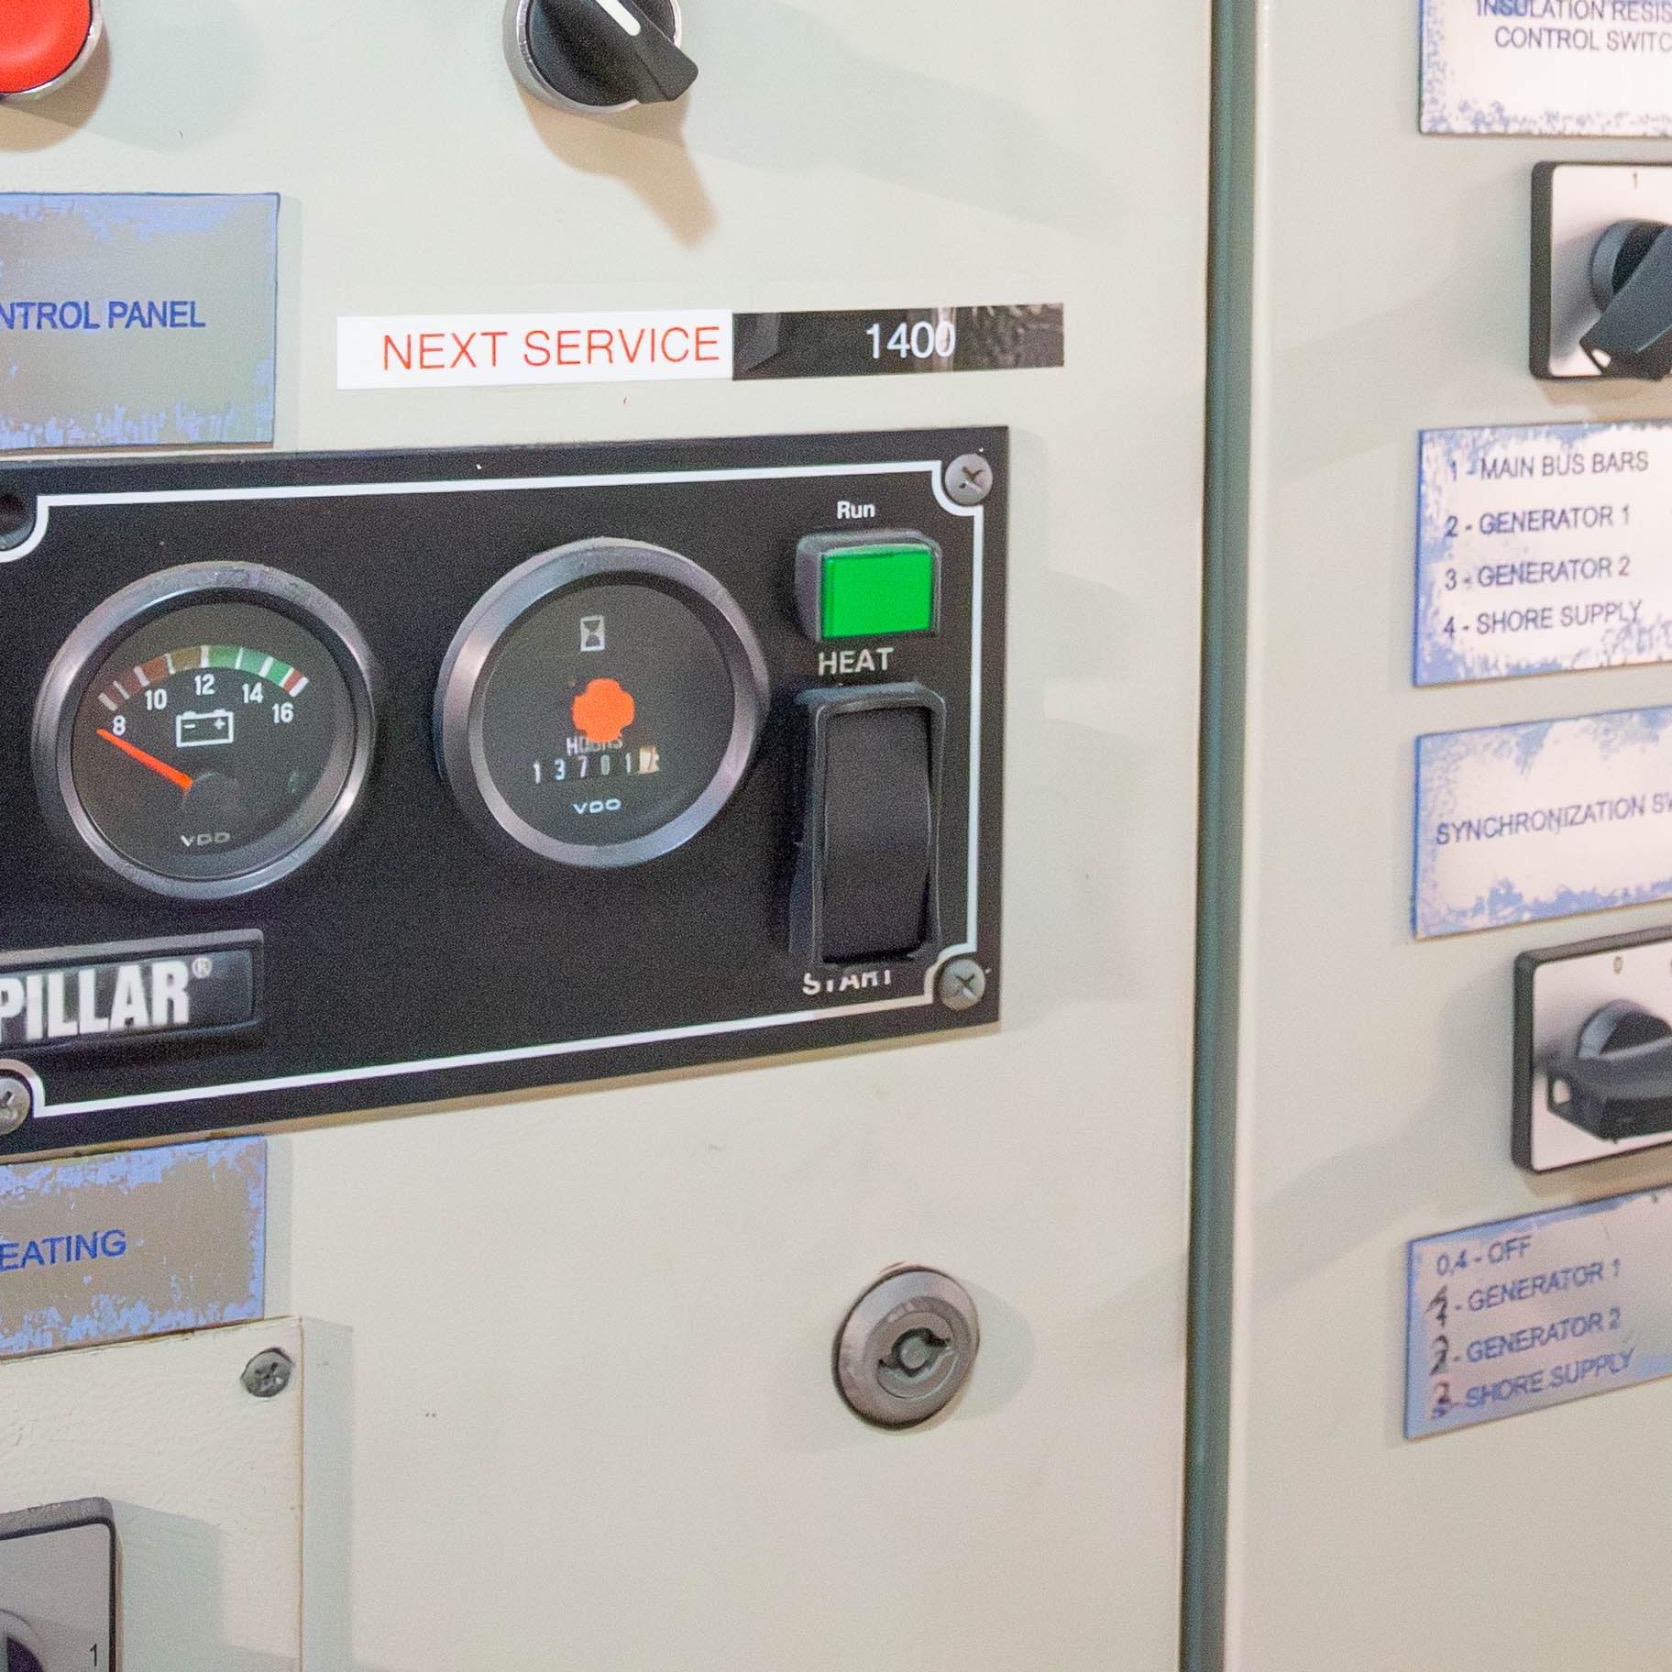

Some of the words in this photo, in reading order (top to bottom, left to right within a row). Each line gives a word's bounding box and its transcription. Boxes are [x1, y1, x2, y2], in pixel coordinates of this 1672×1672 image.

[1495, 26, 1599, 51] CONTROL
[108, 300, 206, 329] PANEL
[382, 331, 508, 370] NEXT
[523, 326, 720, 368] SERVICE
[866, 320, 956, 359] 1400
[1480, 456, 1534, 480] MAIN
[1542, 454, 1585, 476] BUS
[1592, 451, 1649, 474] BARS
[836, 501, 876, 519] Run
[1445, 516, 1458, 537] 2
[1479, 507, 1614, 536] GENERATOR
[1624, 506, 1630, 524] 1
[1445, 569, 1457, 590] 3
[1479, 559, 1613, 587] GENERATOR
[1619, 556, 1630, 576] 2
[1443, 617, 1456, 639] 4
[1477, 607, 1554, 635] SHORE
[1560, 600, 1642, 627] SUPPLY
[818, 647, 894, 676] HEAT
[145, 689, 168, 710] 10
[194, 675, 215, 695] 12
[242, 683, 263, 703] 14
[113, 716, 126, 735] 8
[272, 703, 294, 723] 16
[1435, 795, 1645, 846] SYNCHRONIZATION
[1488, 1235, 1532, 1264] OFF
[1468, 1261, 1604, 1312] GENERATOR
[1614, 1259, 1620, 1276] 1
[1465, 1311, 1602, 1363] GENERATOR
[1609, 1307, 1621, 1331] 2
[1465, 1369, 1544, 1409] SHORE
[1549, 1347, 1635, 1389] SUPPLY
[89, 1644, 100, 1667] 1
